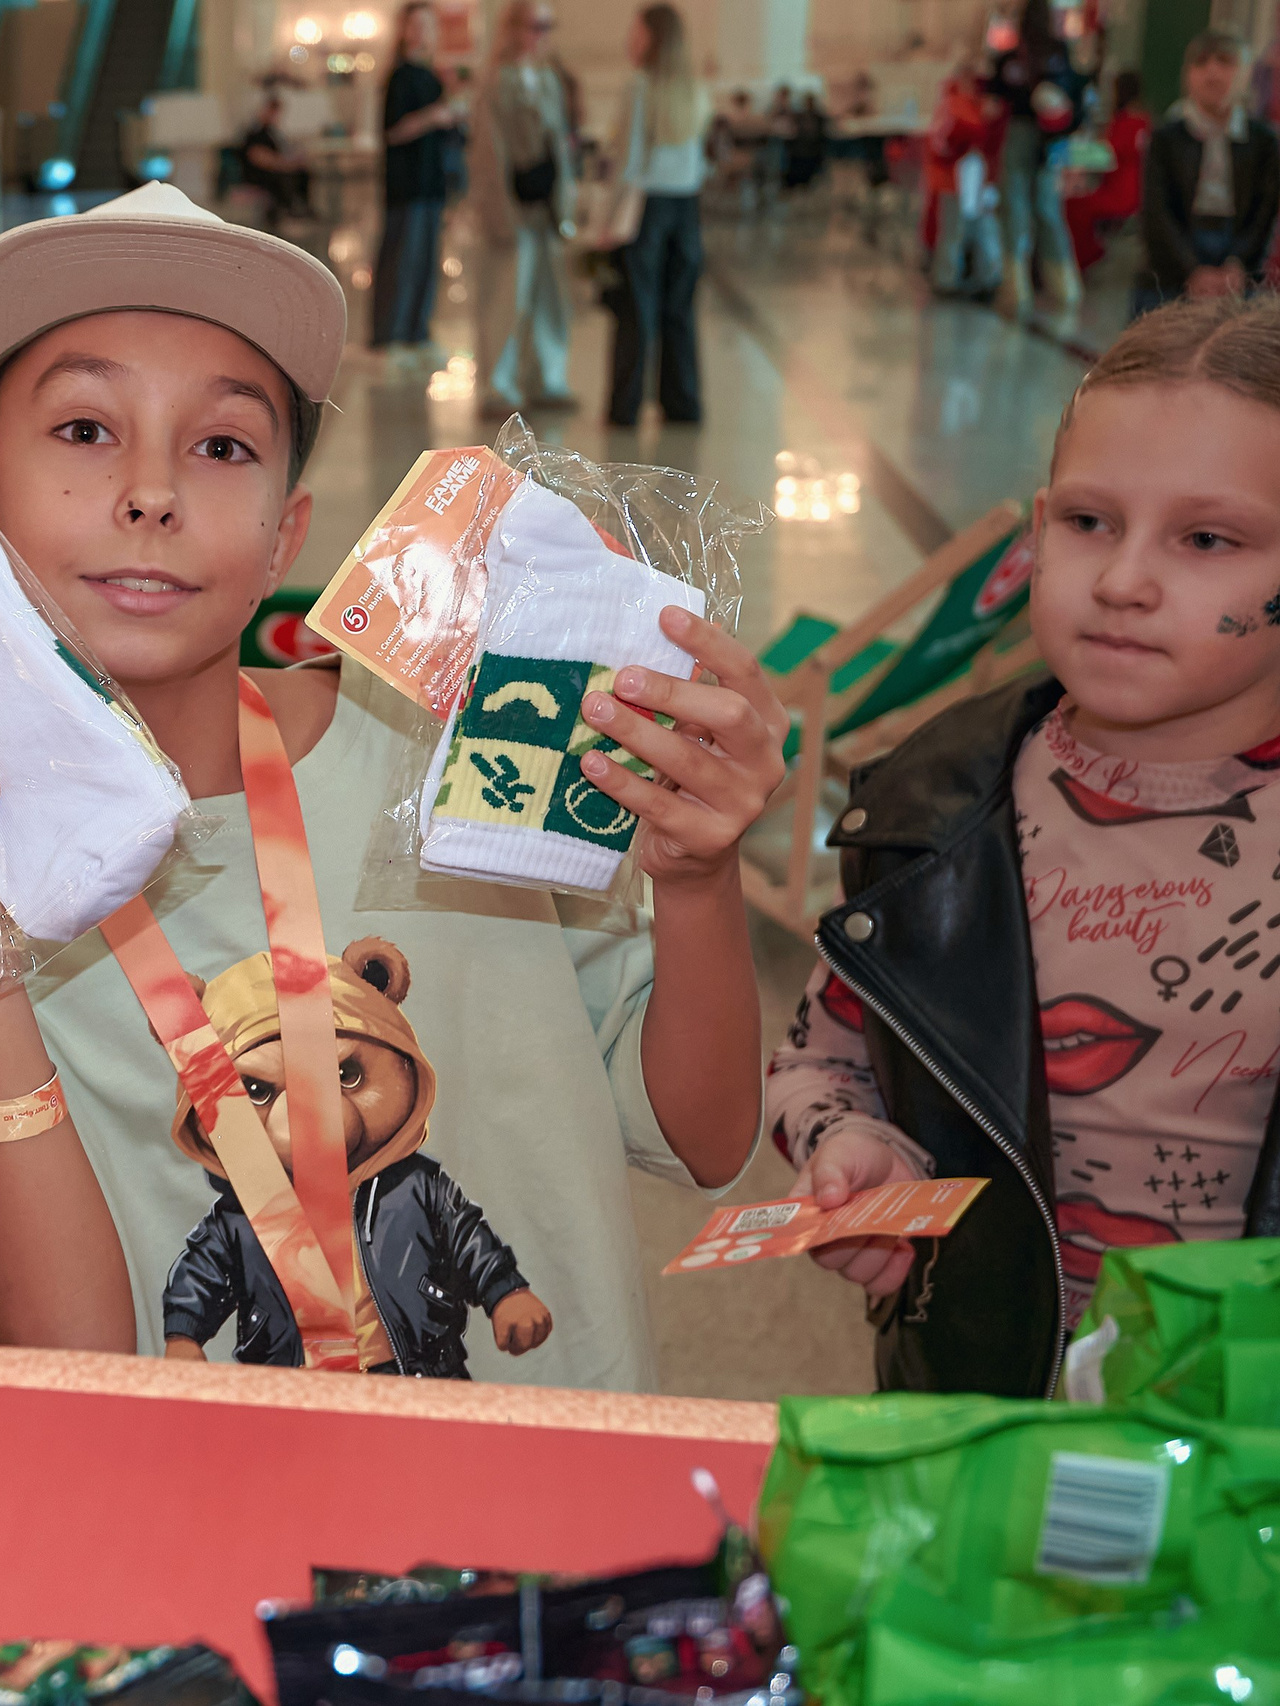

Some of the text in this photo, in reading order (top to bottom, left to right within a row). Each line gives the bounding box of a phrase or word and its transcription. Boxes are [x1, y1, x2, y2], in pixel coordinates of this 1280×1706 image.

[424, 459, 465, 511] FAME
[433, 456, 480, 516] FLAME
[1067, 899, 1186, 955] beauty
